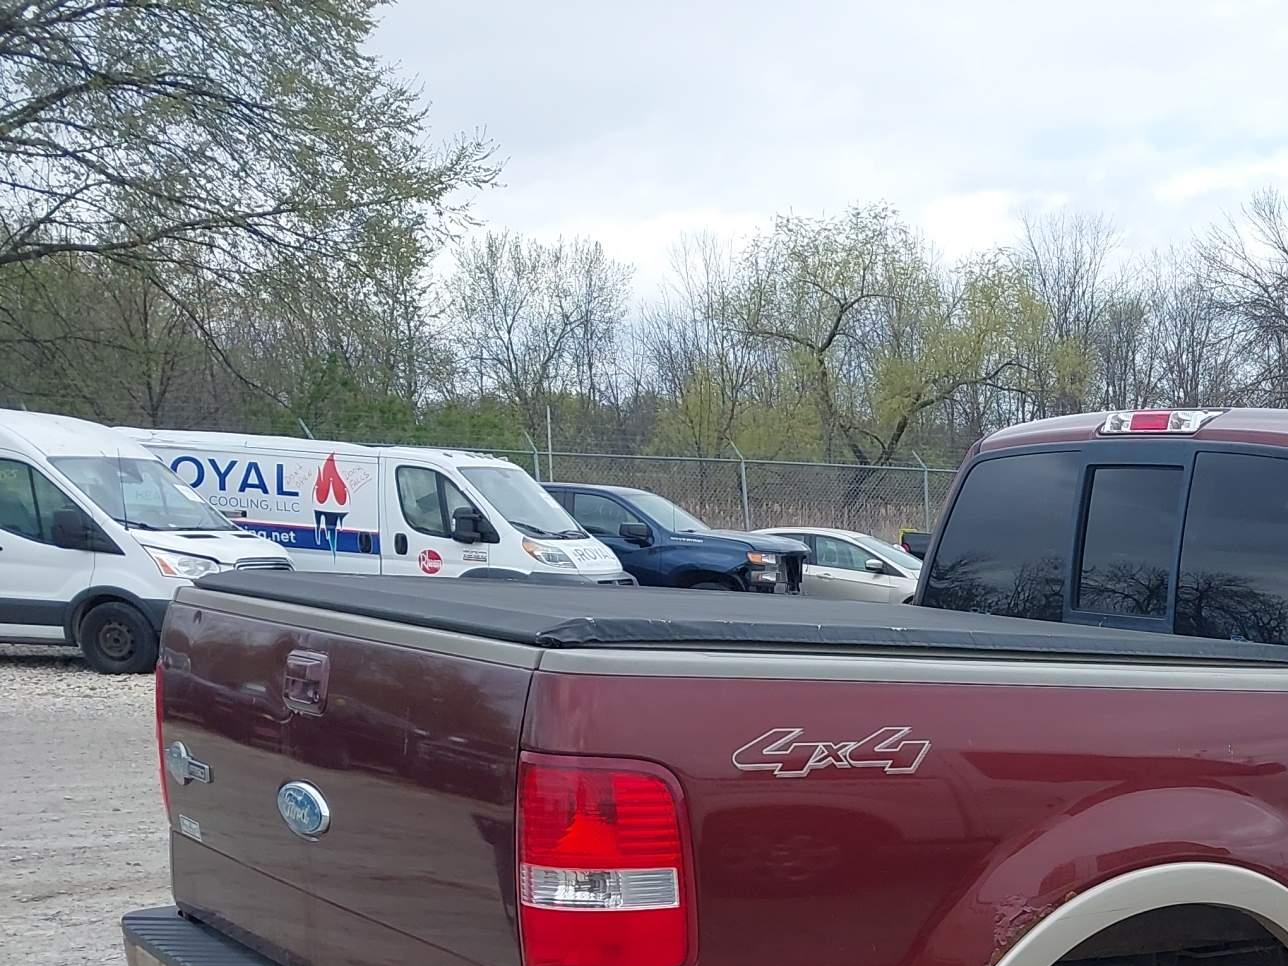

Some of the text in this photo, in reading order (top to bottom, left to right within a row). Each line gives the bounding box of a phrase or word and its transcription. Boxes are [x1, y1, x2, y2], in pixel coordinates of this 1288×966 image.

[170, 456, 300, 497] OYAL
[209, 495, 300, 512] COOLING, LLC
[732, 726, 931, 778] 4x4
